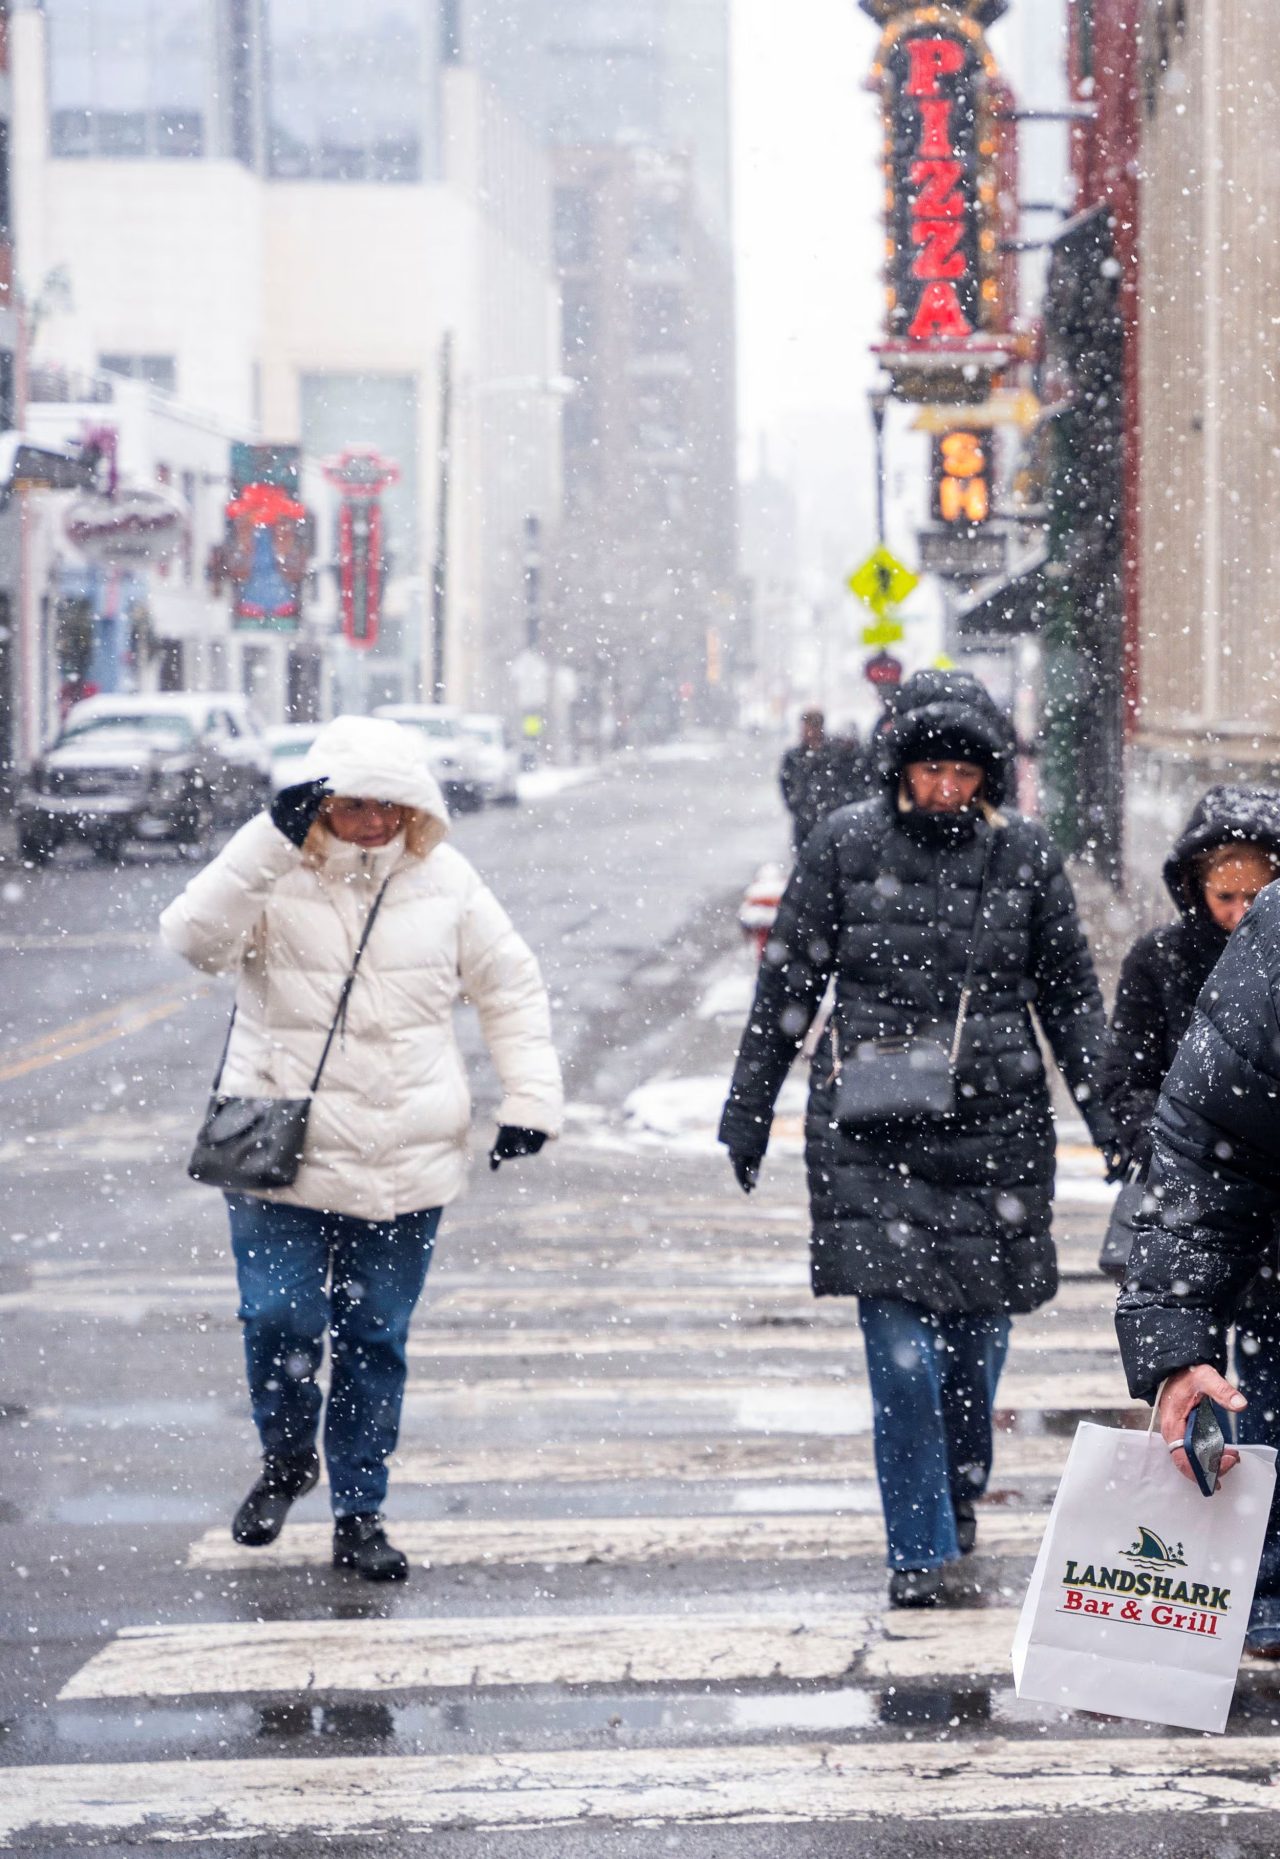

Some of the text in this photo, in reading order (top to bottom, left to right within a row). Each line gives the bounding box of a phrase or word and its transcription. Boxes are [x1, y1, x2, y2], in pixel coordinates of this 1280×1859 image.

[906, 38, 972, 338] PIZZA
[1063, 1560, 1231, 1610] LANDSHARK
[1063, 1590, 1217, 1635] Bar & Grill
